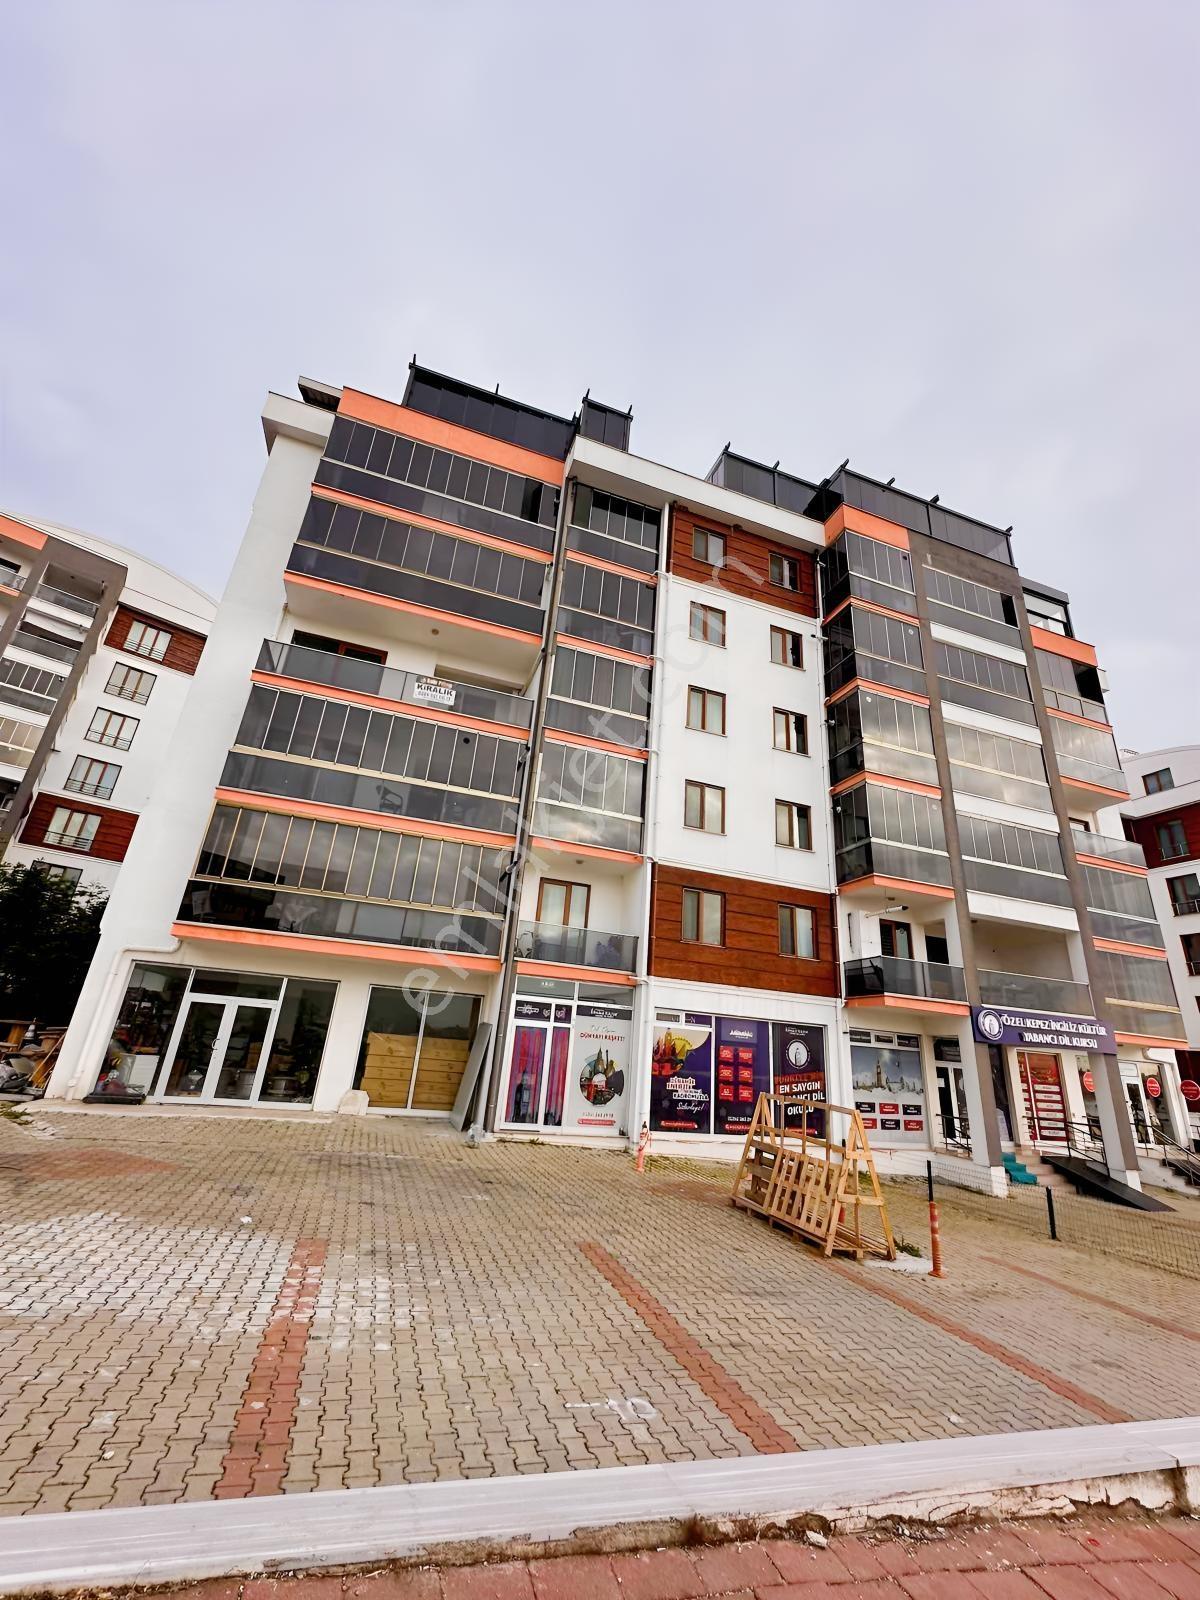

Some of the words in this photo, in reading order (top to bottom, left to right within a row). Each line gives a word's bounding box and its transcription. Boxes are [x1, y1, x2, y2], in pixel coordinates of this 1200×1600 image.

[1002, 1013, 1025, 1027] ÖZEL
[1026, 1018, 1050, 1030] KEPEZ
[1050, 1019, 1078, 1032] İNGİLİZ
[1078, 1022, 1107, 1036] KÜLTÜR
[1023, 1032, 1058, 1045] YABANCI
[1059, 1034, 1072, 1046] DİL
[1072, 1037, 1098, 1048] KURSU
[779, 1084, 790, 1094] EN
[792, 1081, 821, 1091] SAYGIN
[812, 1090, 825, 1101] DİL
